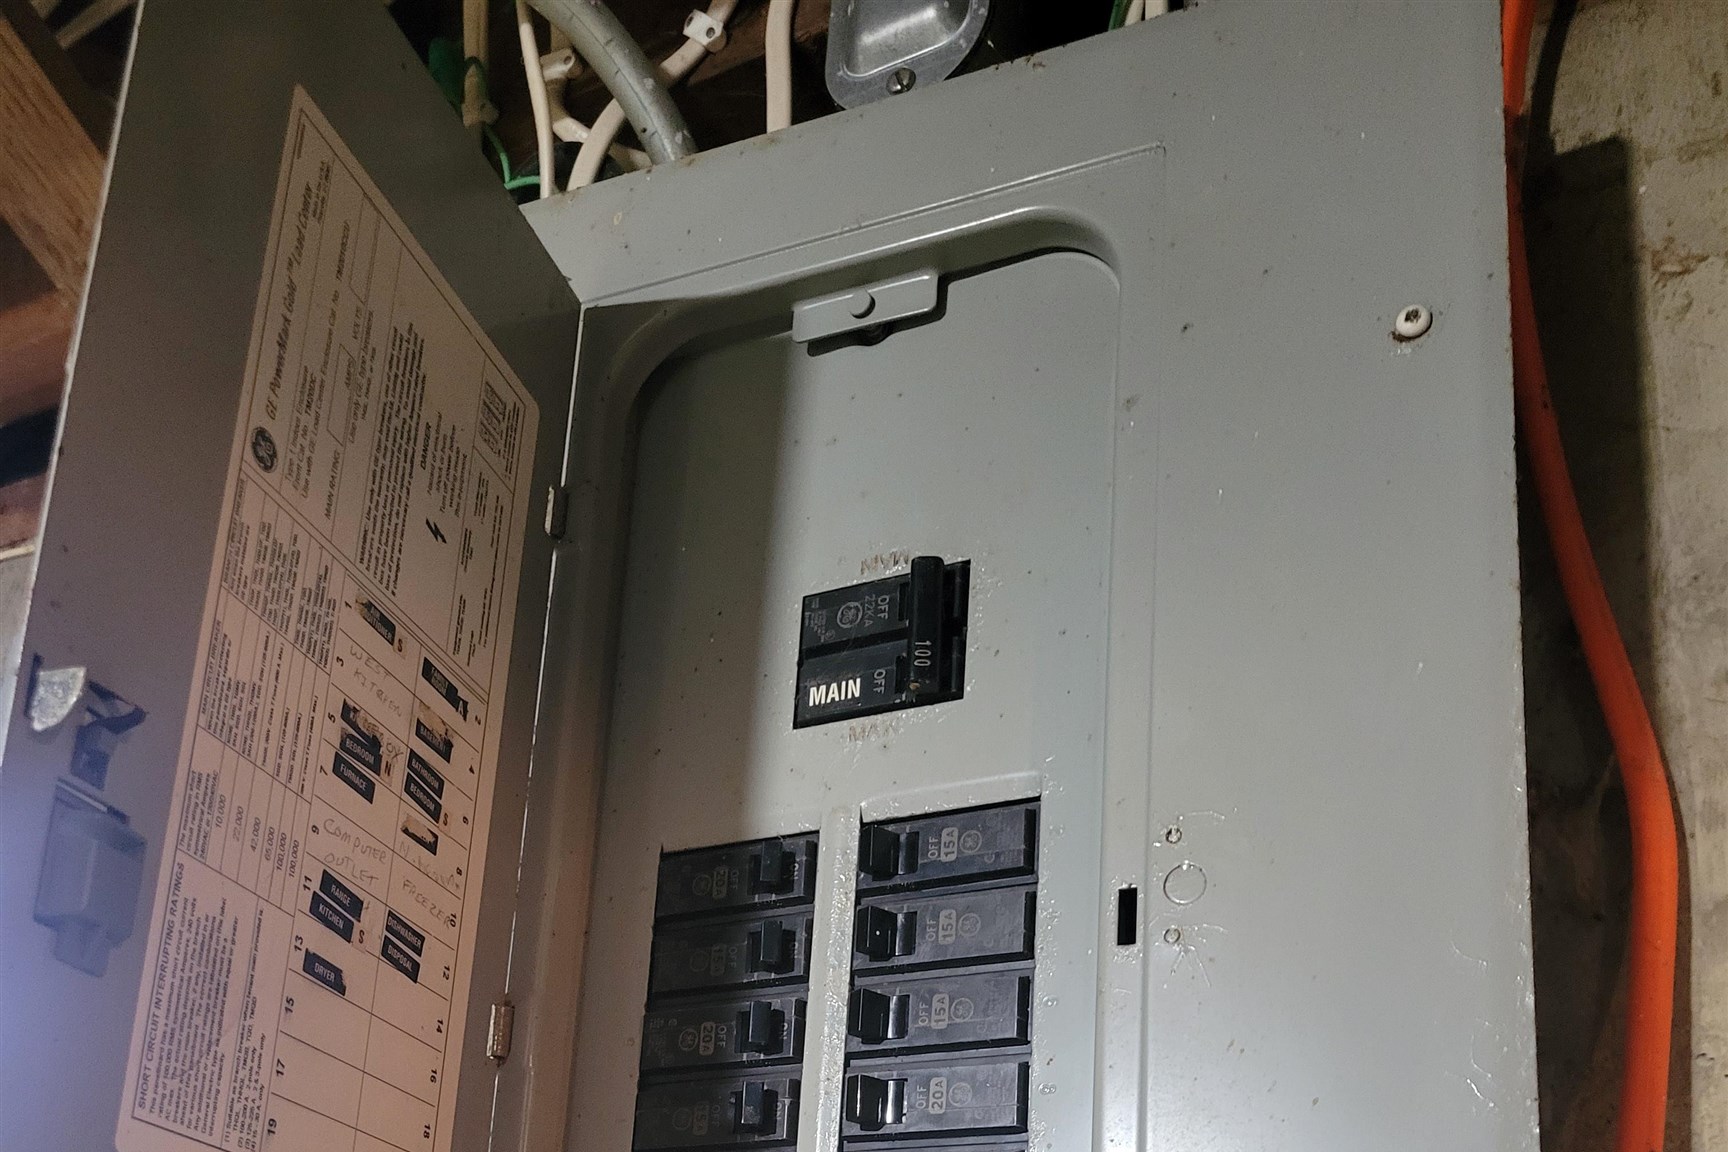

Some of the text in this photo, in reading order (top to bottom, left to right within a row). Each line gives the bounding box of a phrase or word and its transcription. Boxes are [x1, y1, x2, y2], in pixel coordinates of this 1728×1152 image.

[297, 181, 312, 230] Center
[290, 224, 305, 265] Load
[268, 313, 291, 398] PowerMark
[265, 395, 277, 420] GE
[419, 421, 431, 470] DANGER
[324, 449, 340, 520] MAIN RATING
[344, 600, 352, 609] 1
[863, 594, 876, 628] 22KA
[877, 595, 890, 620] OFF
[335, 655, 344, 667] 3
[349, 644, 391, 680] WEST
[914, 640, 932, 667] 100
[808, 678, 862, 707] MAIN
[872, 668, 886, 694] OFF
[327, 711, 336, 723] 5
[474, 714, 481, 725] 2
[344, 737, 375, 766] BEDROOM
[319, 764, 328, 775] 7
[339, 762, 368, 791] FURNACE
[384, 759, 391, 777] N
[410, 758, 441, 791] BATHROOM
[468, 764, 475, 774] 4
[215, 793, 225, 827] 10,000
[409, 782, 436, 812] BEDROOM
[233, 805, 243, 841] 22,000
[310, 824, 319, 835] 9
[462, 815, 469, 825] 6
[250, 816, 261, 851] 42,000
[264, 826, 275, 860] 65,000
[323, 818, 387, 865] COMPUTER
[943, 828, 956, 860] 15A
[276, 831, 287, 870] 100,000
[288, 839, 299, 877] 100,000
[928, 836, 939, 860] OFF
[302, 874, 312, 890] 11
[323, 852, 379, 886] OUTLET
[455, 866, 462, 876] 8
[331, 883, 351, 907] RANGE
[402, 878, 452, 929] FREEZER
[318, 903, 345, 930] KITCHEN
[449, 912, 457, 927] 10
[941, 911, 955, 942] 15A
[293, 934, 303, 951] 13
[358, 928, 365, 945] S
[387, 915, 422, 949] DISHWASHER
[926, 918, 937, 942] OFF
[314, 961, 336, 981] DRYER
[387, 944, 414, 972] DISPOSAL
[138, 861, 184, 1109] SHORT CIRCUIT INTERRUPTING RATINGS
[442, 964, 450, 980] 12
[284, 995, 294, 1013] 15
[918, 1002, 929, 1026] OFF
[933, 996, 947, 1027] 15A
[435, 1018, 444, 1033] 14
[702, 1024, 713, 1053] 20A
[717, 1025, 727, 1048] OFF
[275, 1057, 285, 1076] 17
[429, 1068, 437, 1083] 16
[915, 1085, 928, 1110] OFF
[931, 1080, 945, 1111] 20A
[266, 1117, 277, 1136] 19
[422, 1123, 431, 1139] 18
